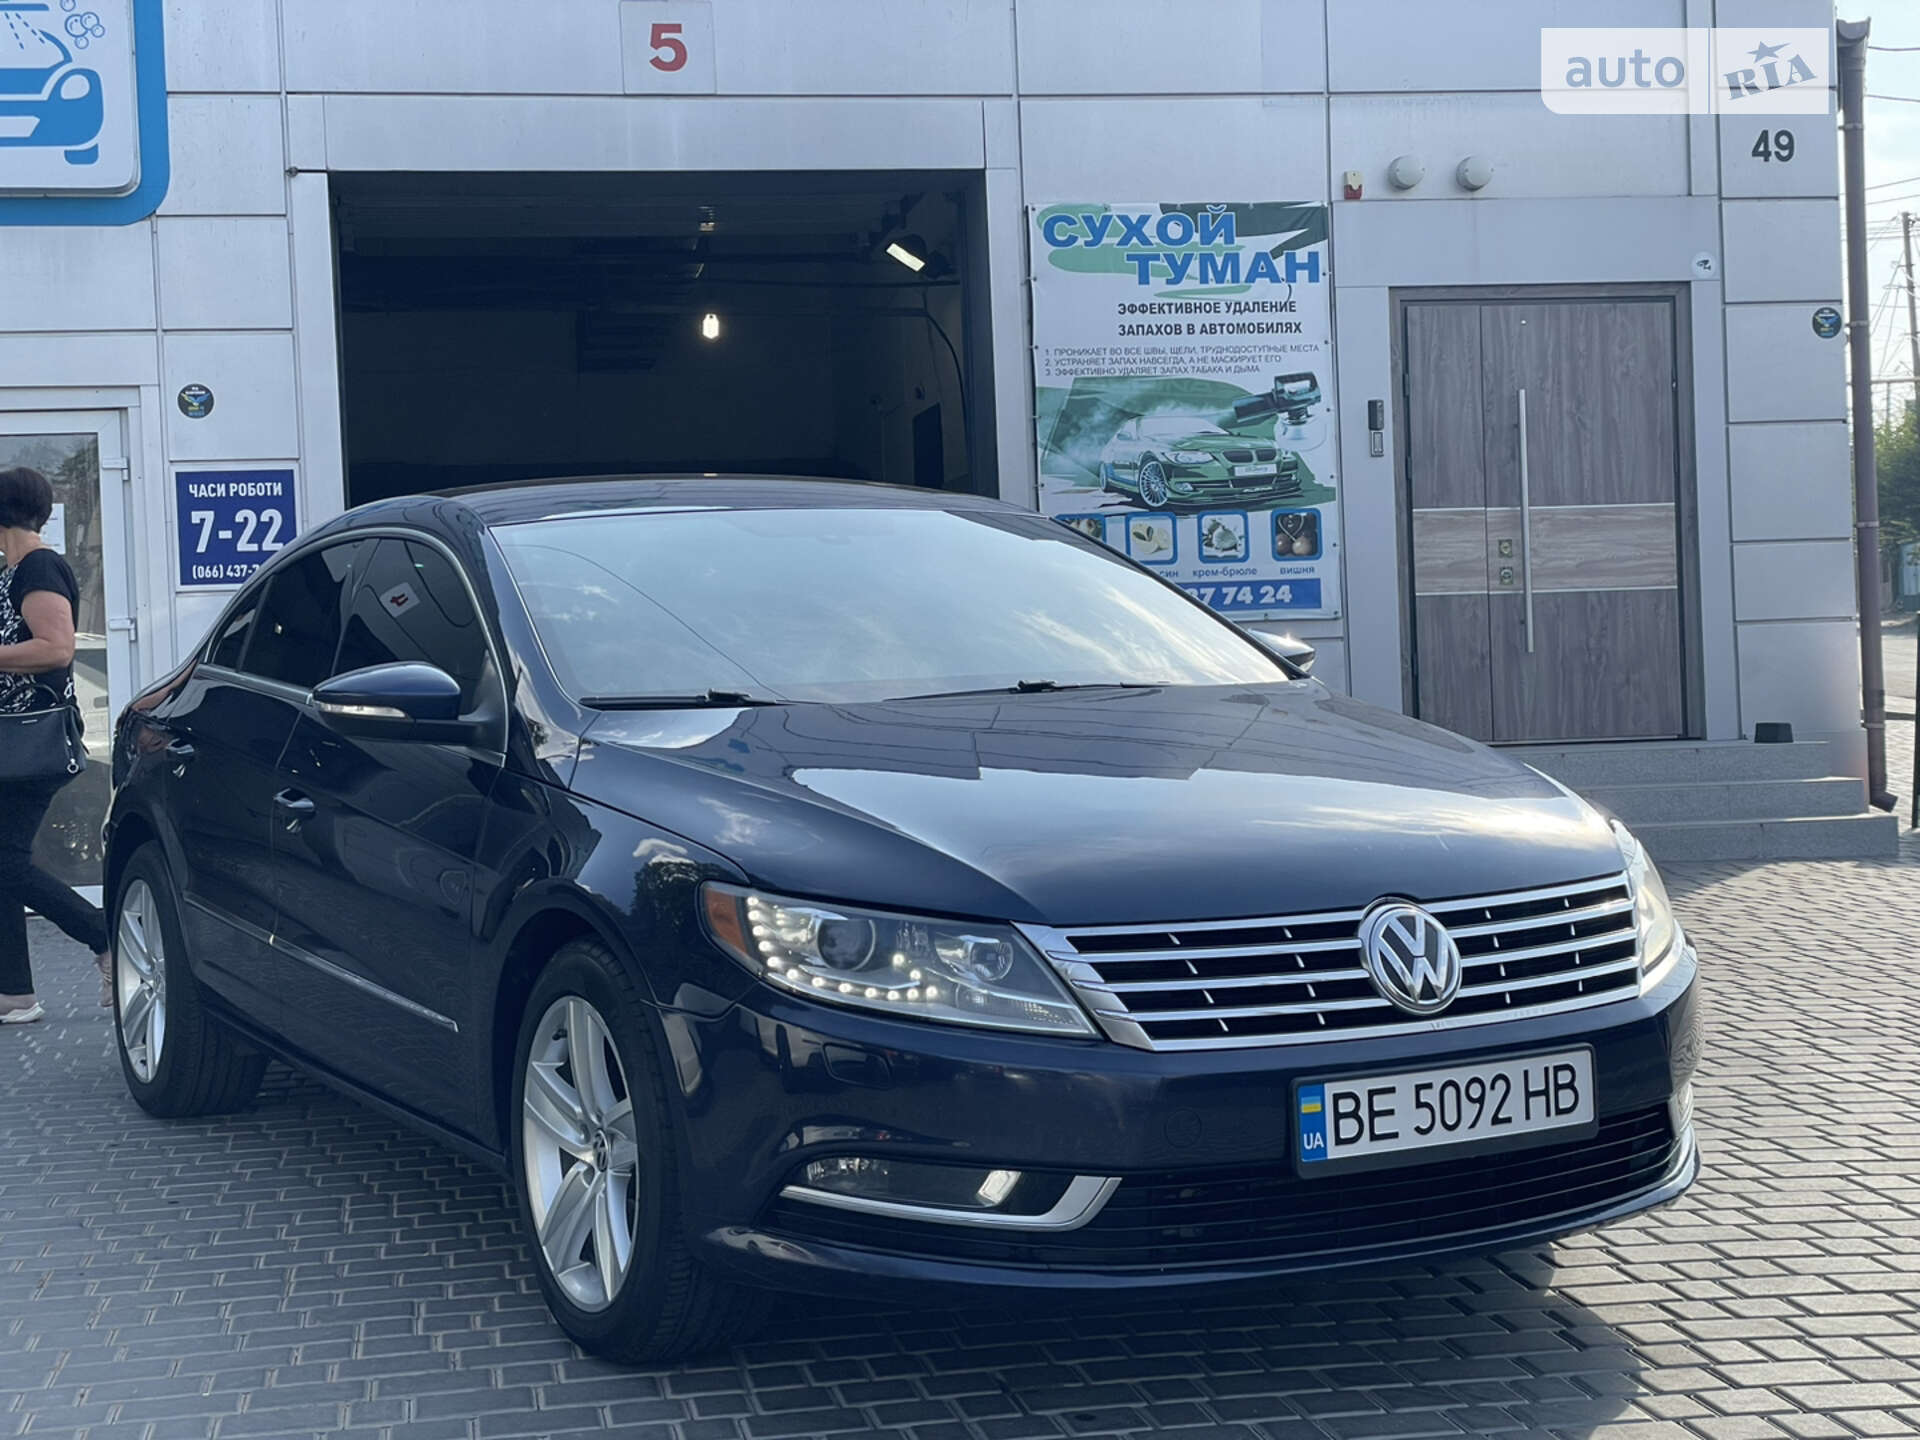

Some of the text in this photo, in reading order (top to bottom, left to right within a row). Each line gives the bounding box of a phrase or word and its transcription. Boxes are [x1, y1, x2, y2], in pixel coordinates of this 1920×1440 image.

[649, 23, 688, 72] 5
[1751, 129, 1795, 162] 49
[1043, 204, 1236, 247] СУХОЙ
[1126, 251, 1320, 286] ТУМАН
[1118, 300, 1297, 315] ЭФФЕКТИВНОЕ УДАЛЕНИЕ
[1118, 322, 1302, 336] ЗАПАХОВ В АВТОМОБИЛЯХ
[1054, 347, 1107, 356] ПРОНИКАЕТ
[1110, 347, 1122, 355] ВО
[1124, 346, 1140, 355] ВСЕ
[1200, 345, 1288, 355] ТРУДНОДОСТУПНЫЕ
[1290, 344, 1320, 353] МЕСТА
[1054, 357, 1106, 366] УСТРАНЯЕТ
[1109, 357, 1137, 365] ЗАПАХ
[1189, 355, 1196, 364] А
[1197, 355, 1209, 364] НЕ
[1211, 354, 1262, 364] МАСКИРУЕТ
[1264, 354, 1281, 363] ЕГО
[1055, 367, 1116, 376] ЭФФЕКТИВНО
[1119, 366, 1157, 376] УДАЛЯЕТ
[1160, 366, 1189, 374] ЗАПАХ
[1191, 365, 1224, 374] ТАБАКА
[1225, 365, 1232, 373] И
[1233, 364, 1260, 374] ДЫМА
[189, 482, 282, 498] ЧАСИ РОБОТИ
[191, 508, 284, 553] 7-22
[192, 564, 223, 579] (066)
[1192, 566, 1257, 578] крем-брюле
[1280, 566, 1315, 575] вишня
[1222, 586, 1253, 605] 74
[1259, 584, 1293, 604] 24
[1331, 1062, 1580, 1147] BE 5092 HB
[1303, 1132, 1324, 1150] UA
